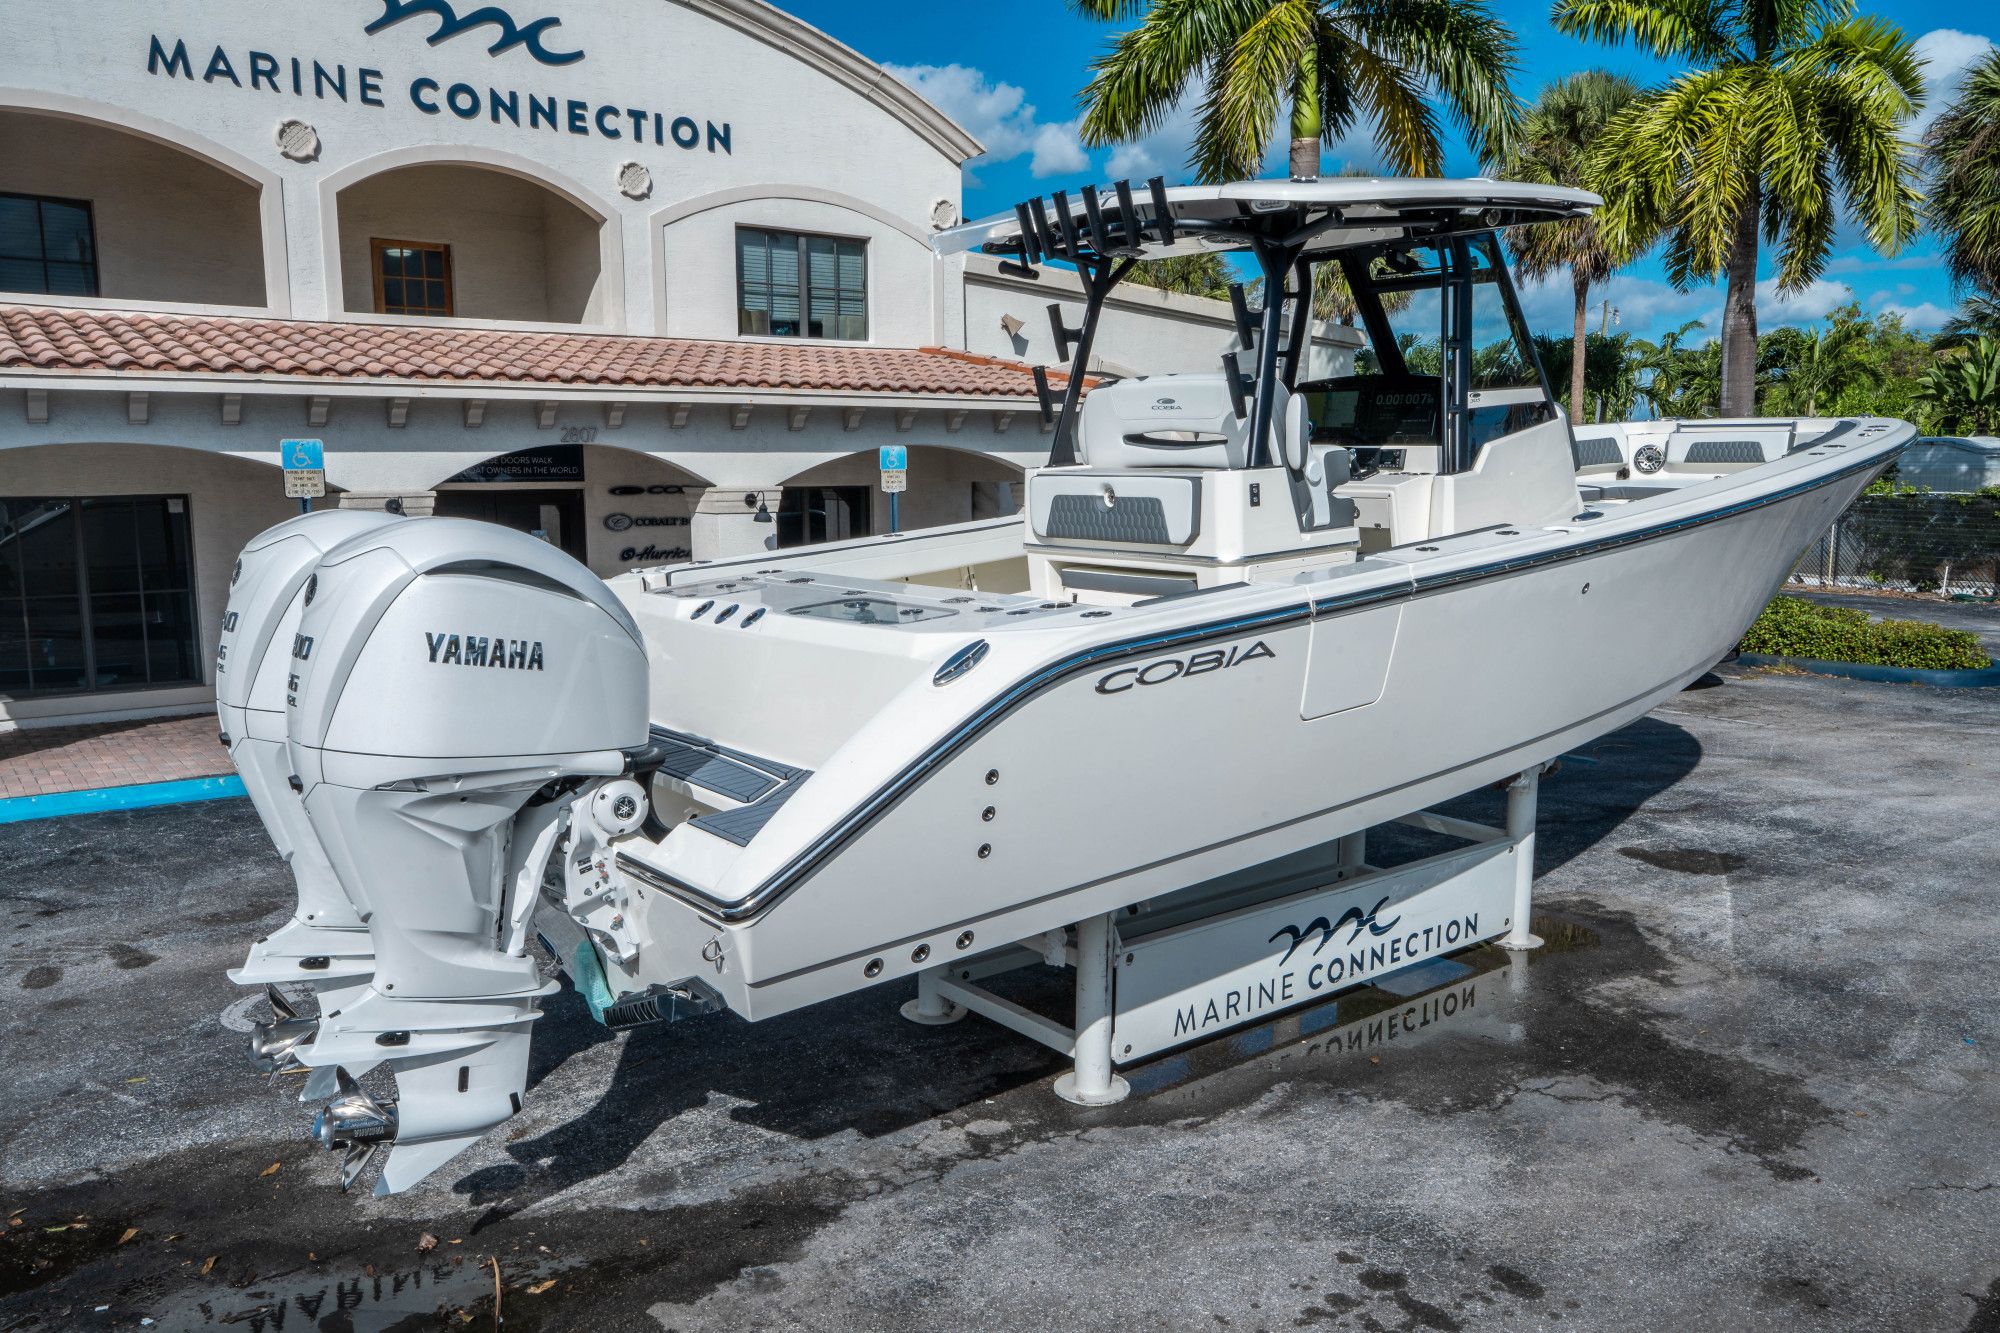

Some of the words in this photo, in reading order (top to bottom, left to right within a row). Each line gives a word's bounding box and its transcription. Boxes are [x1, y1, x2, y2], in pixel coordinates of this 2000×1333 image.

[146, 34, 385, 107] MARINE
[409, 76, 732, 156] CONNECTION
[560, 426, 598, 443] 2807
[500, 456, 529, 465] DOORS
[532, 456, 553, 465] WALK
[487, 466, 522, 475] OWNERS
[523, 466, 532, 474] IN
[534, 466, 548, 474] THE
[550, 466, 578, 474] WORLD
[635, 516, 678, 527] COBALT
[635, 544, 692, 561] Hurric
[425, 631, 544, 672] YAMAHA
[1094, 640, 1276, 695] COBIA
[1173, 972, 1295, 1037] MARINE
[1307, 913, 1479, 991] CONNECTION
